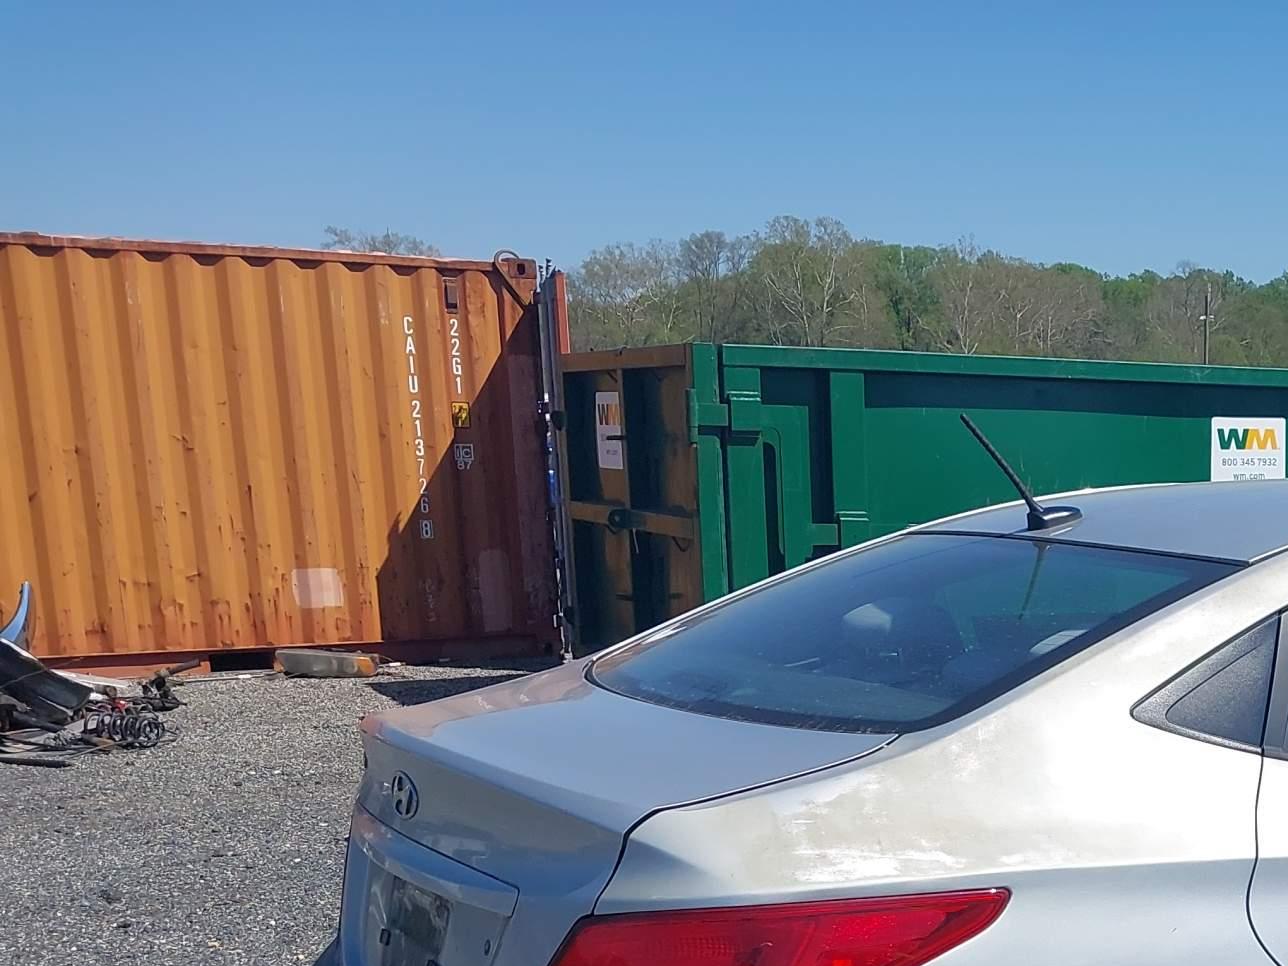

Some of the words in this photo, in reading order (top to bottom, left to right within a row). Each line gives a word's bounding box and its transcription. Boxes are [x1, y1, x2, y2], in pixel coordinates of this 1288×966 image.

[449, 318, 462, 394] 22G1
[597, 403, 622, 426] WM
[403, 316, 419, 393] CAIU
[411, 400, 429, 514] 213726
[421, 520, 432, 539] 8
[1216, 428, 1277, 450] WM
[1221, 458, 1238, 467] 800
[1240, 458, 1256, 467] 345
[1257, 458, 1277, 467] 7932
[1233, 473, 1266, 481] wm.com
